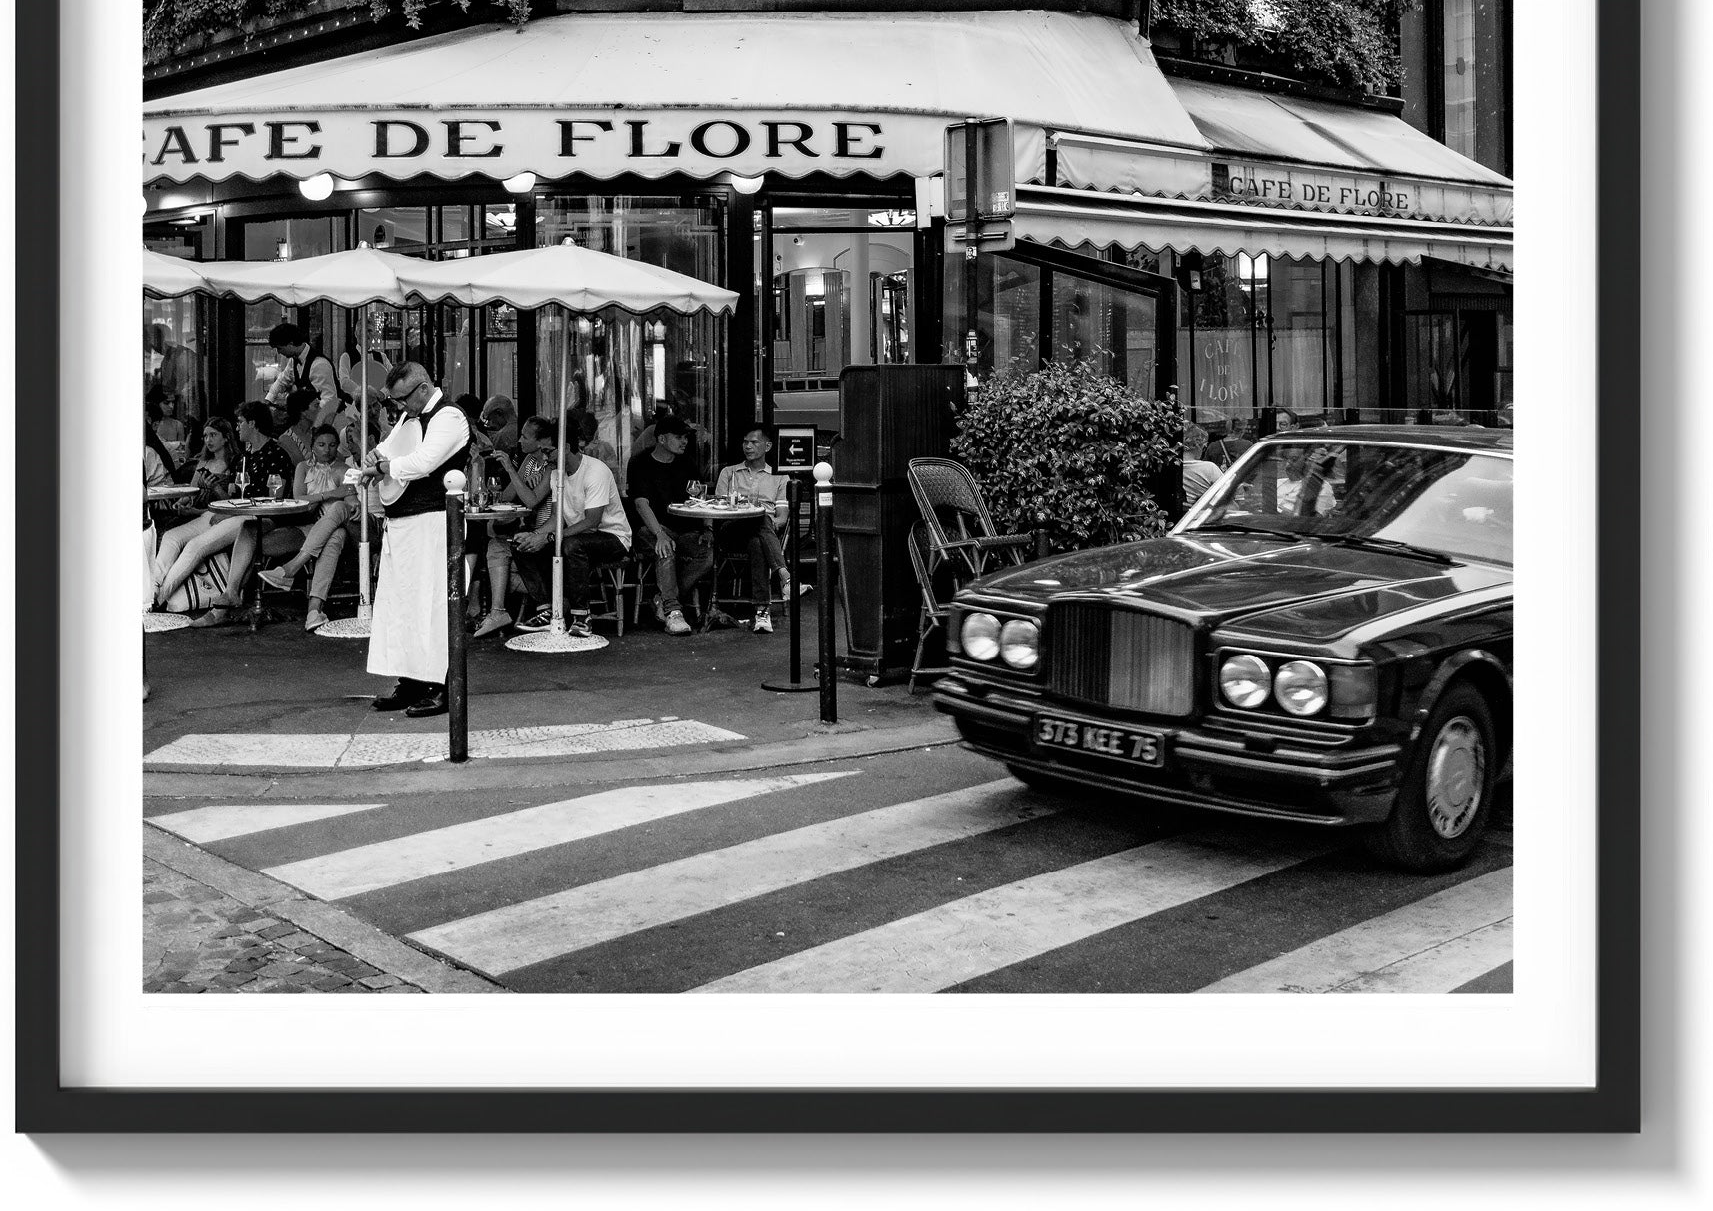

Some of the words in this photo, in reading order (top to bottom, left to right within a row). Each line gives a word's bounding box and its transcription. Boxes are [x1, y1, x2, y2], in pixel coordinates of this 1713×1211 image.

[143, 119, 322, 166] AFE
[370, 119, 506, 160] DE
[556, 118, 887, 160] FLORE
[1229, 176, 1292, 199] CAFE
[1302, 183, 1331, 203] DE
[1339, 187, 1409, 210] FLORE
[1039, 718, 1079, 745] 373
[1129, 735, 1158, 761] 75
